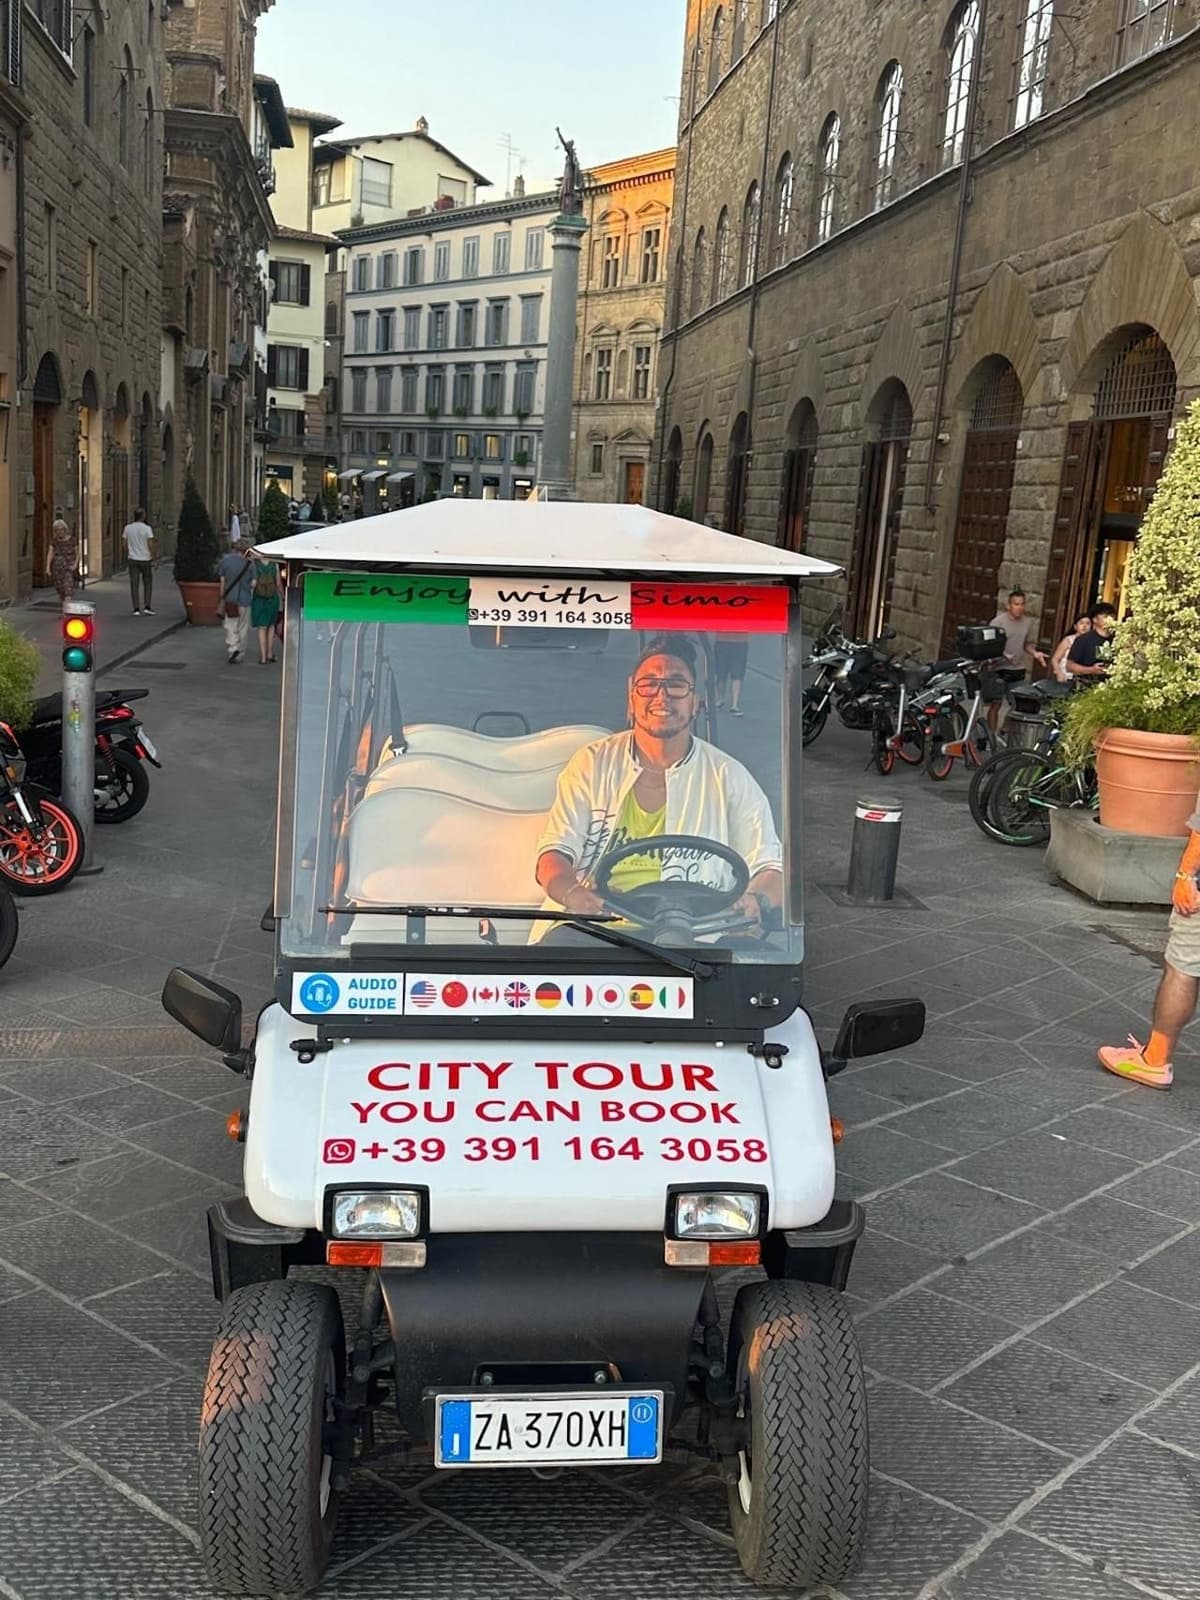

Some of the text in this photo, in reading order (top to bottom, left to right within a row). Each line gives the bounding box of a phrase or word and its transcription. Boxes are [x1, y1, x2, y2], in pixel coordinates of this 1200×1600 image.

[333, 578, 762, 607] Enjoy with Simo
[479, 608, 634, 625] +39 391 164 3058
[348, 978, 398, 990] AUDIO
[348, 997, 397, 1010] GUIDE
[367, 1062, 720, 1092] CITY TOUR
[350, 1100, 742, 1124] YOU CAN BOOK
[361, 1136, 769, 1163] +39 391 164 3058
